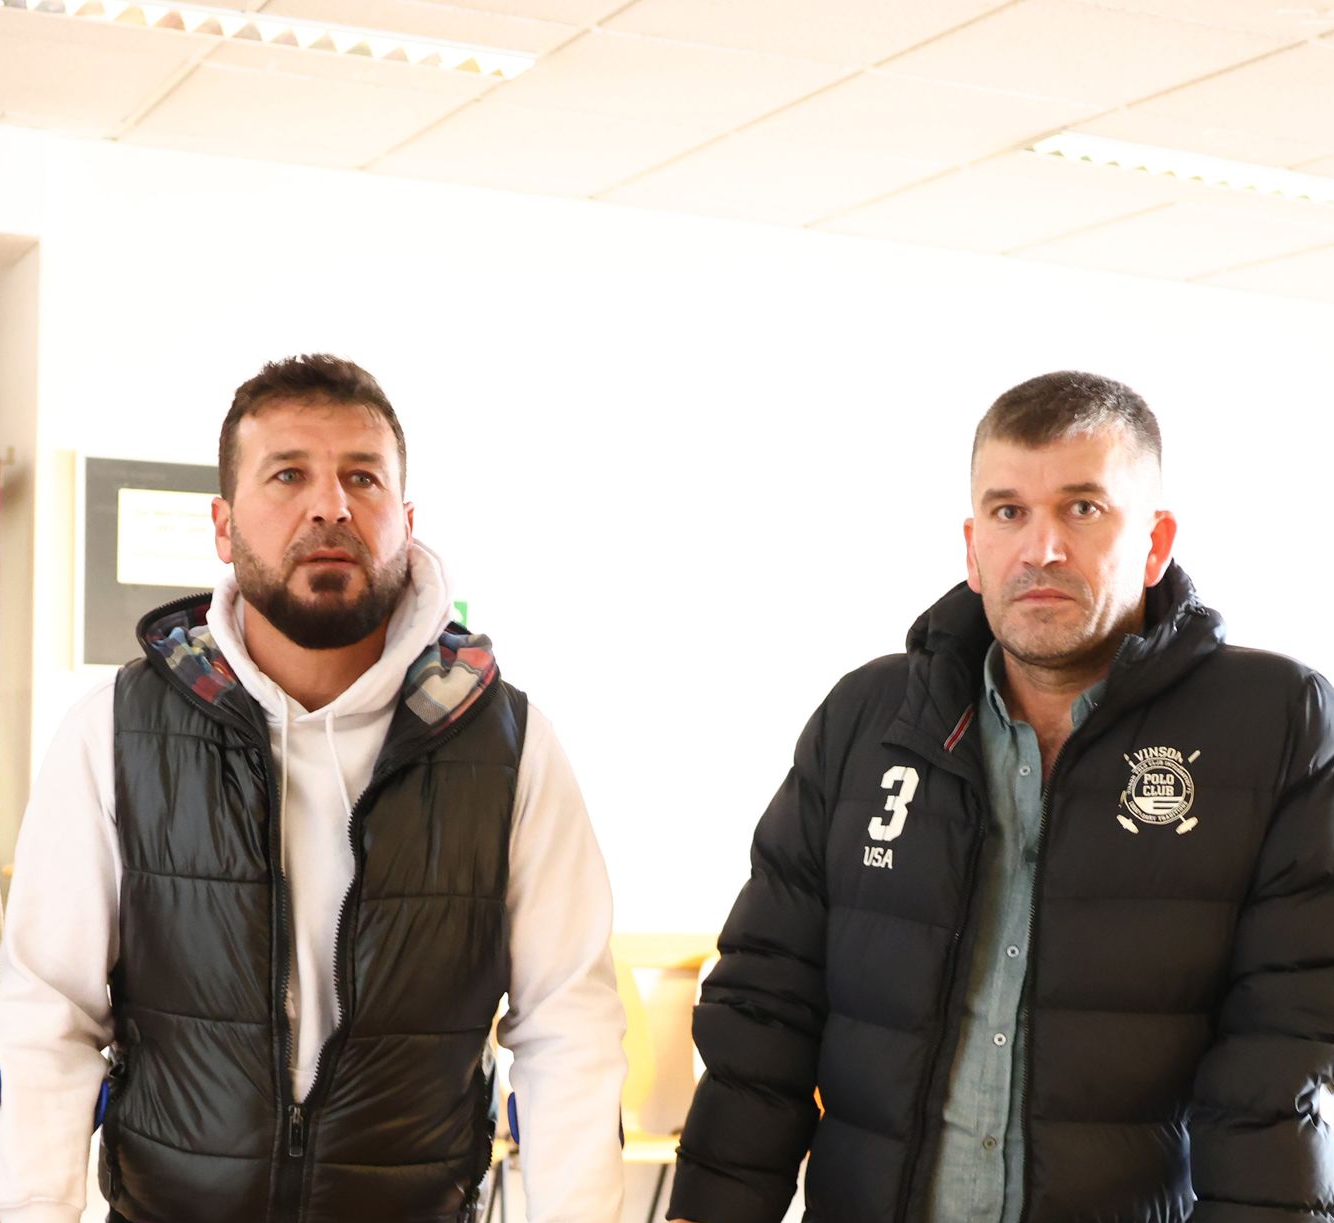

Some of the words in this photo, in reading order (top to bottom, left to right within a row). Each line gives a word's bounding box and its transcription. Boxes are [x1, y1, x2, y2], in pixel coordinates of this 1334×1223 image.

[1142, 773, 1175, 786] POLO
[1142, 785, 1175, 797] CLUB
[867, 765, 920, 842] 3
[862, 845, 894, 870] USA
